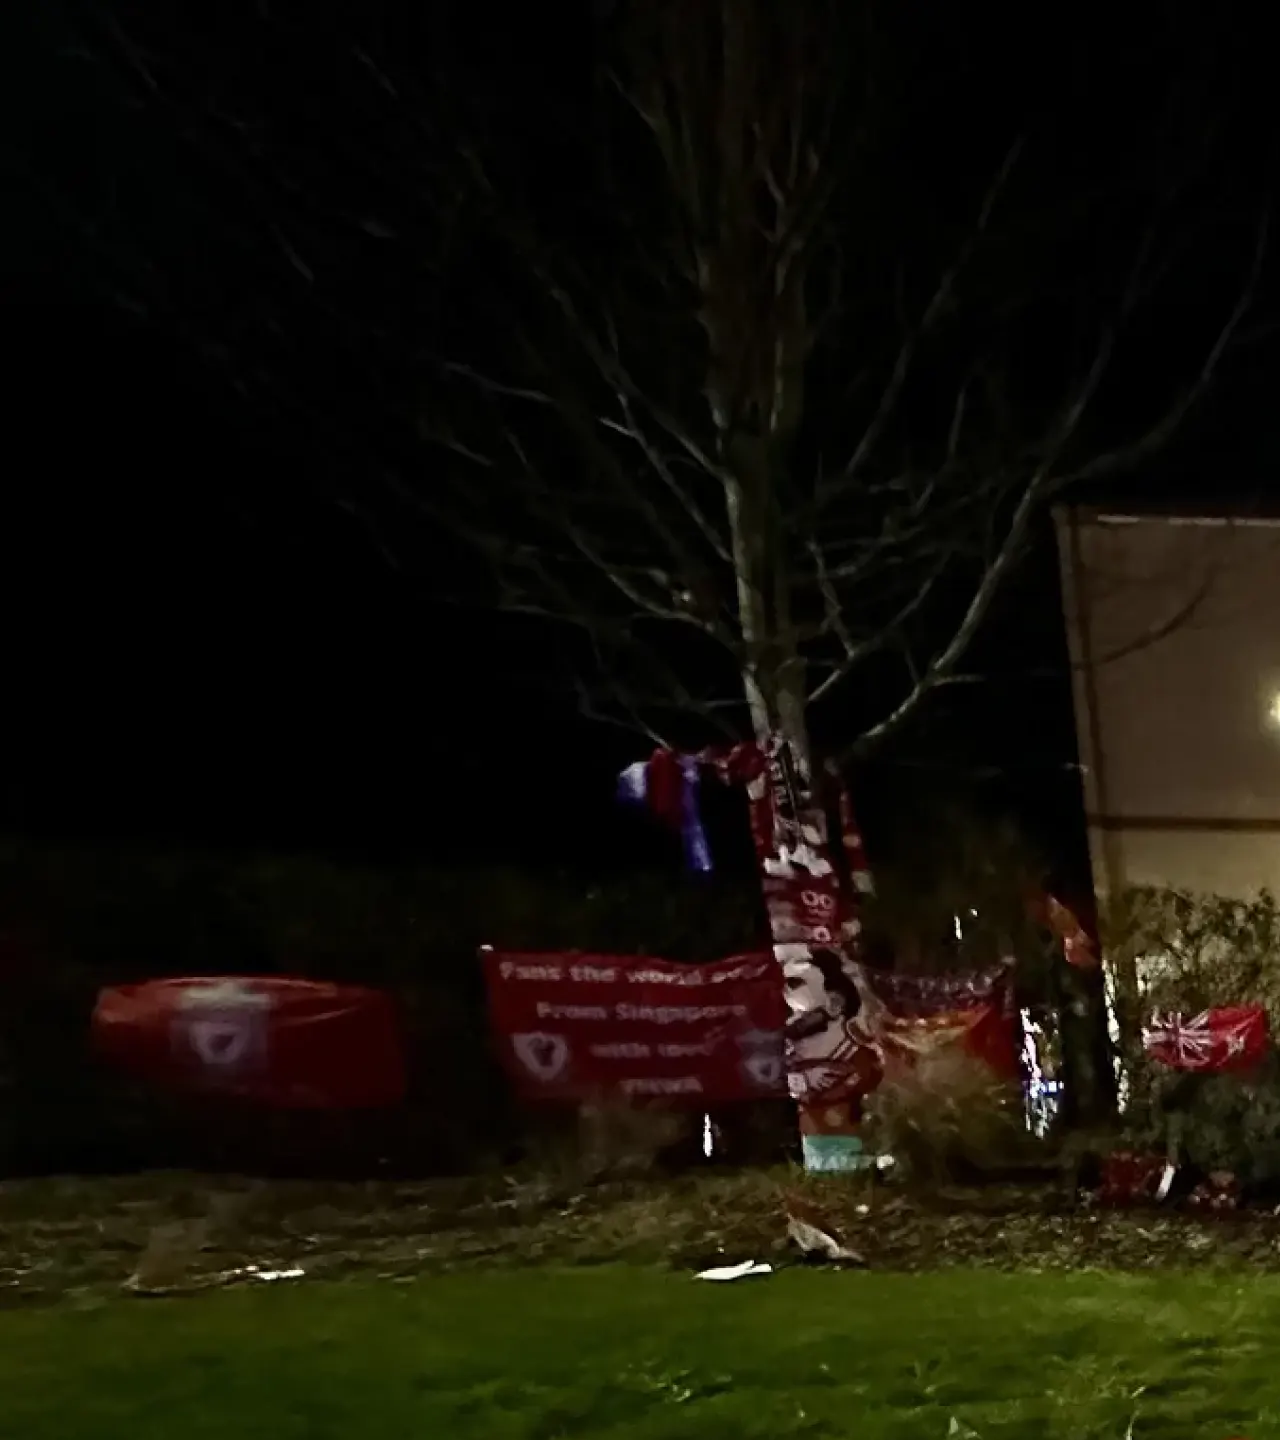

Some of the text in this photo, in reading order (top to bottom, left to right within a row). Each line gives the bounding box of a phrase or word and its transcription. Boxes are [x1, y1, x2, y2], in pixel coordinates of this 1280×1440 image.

[500, 961, 561, 981] Fans
[569, 965, 617, 983] the
[625, 969, 704, 986] world
[536, 1002, 748, 1025] From Singapore
[589, 1042, 651, 1059] with
